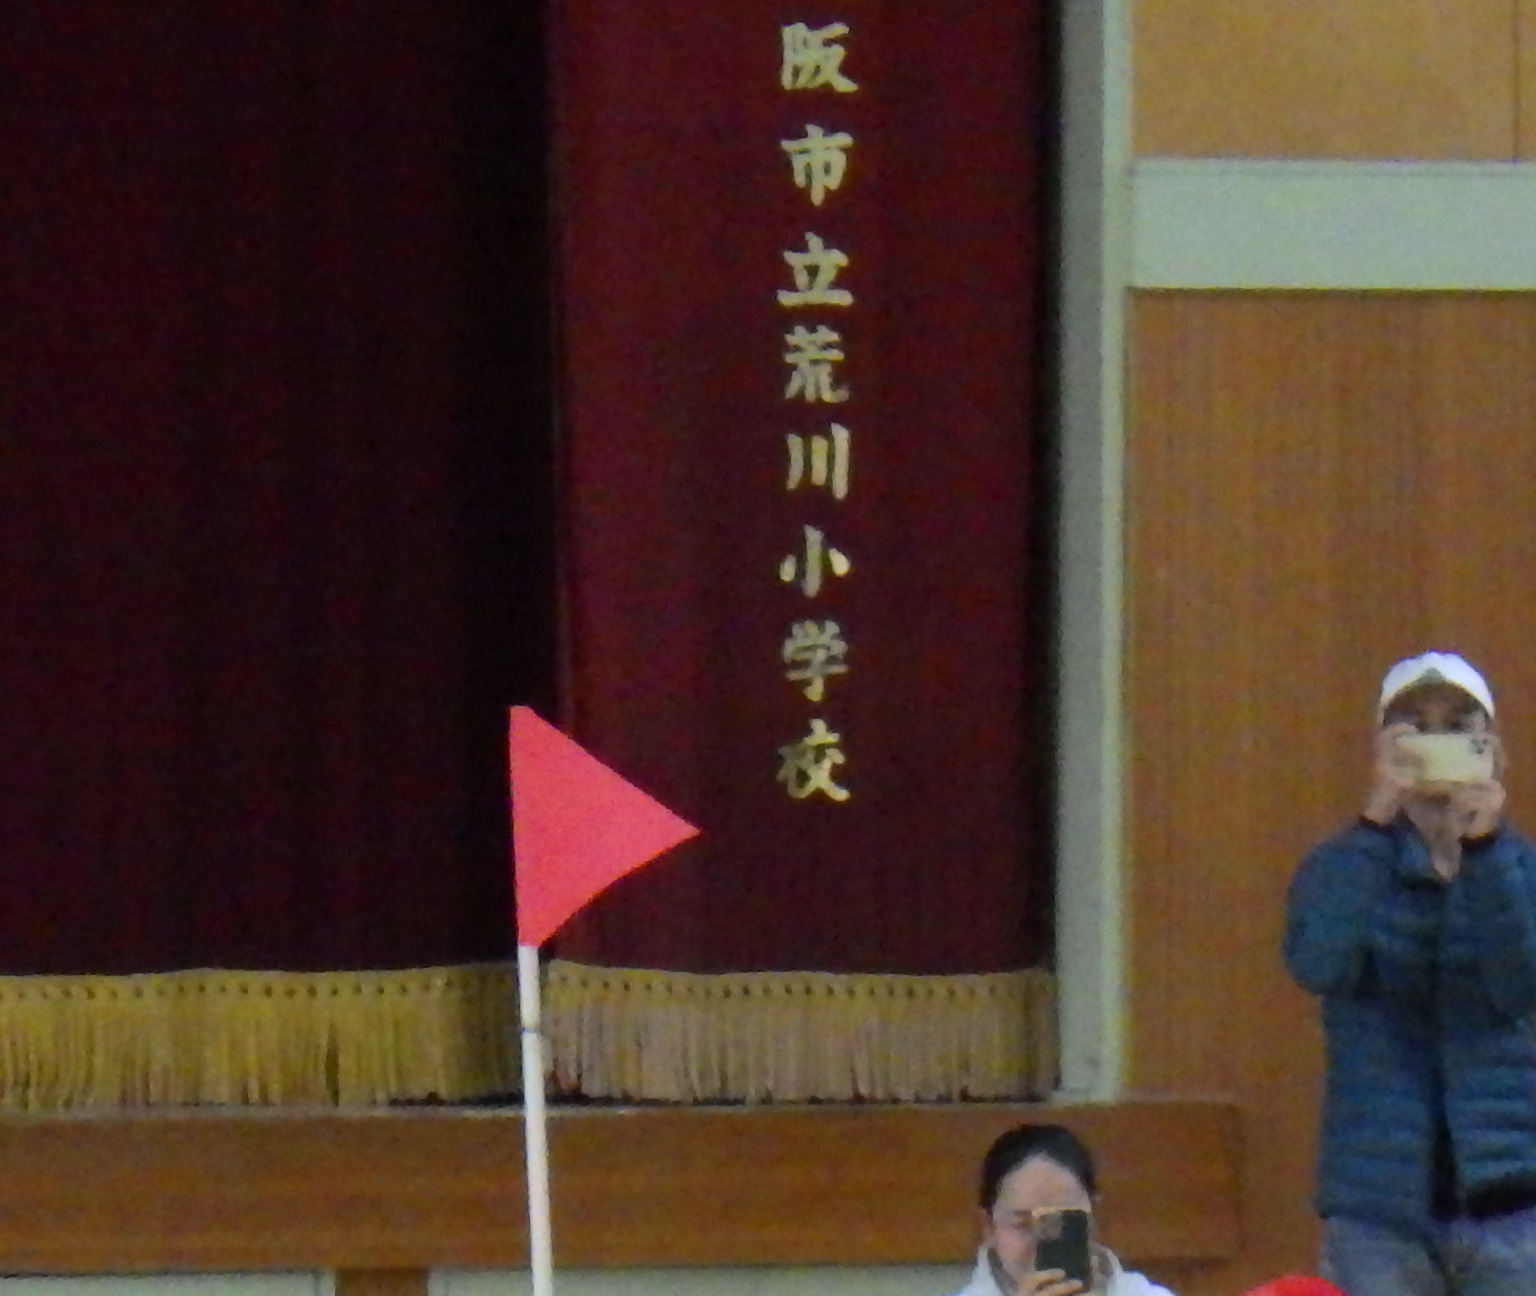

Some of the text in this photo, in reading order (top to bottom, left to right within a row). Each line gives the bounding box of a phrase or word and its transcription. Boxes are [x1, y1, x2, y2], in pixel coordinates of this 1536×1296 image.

[776, 22, 859, 802] 阪市立荒川小学校
